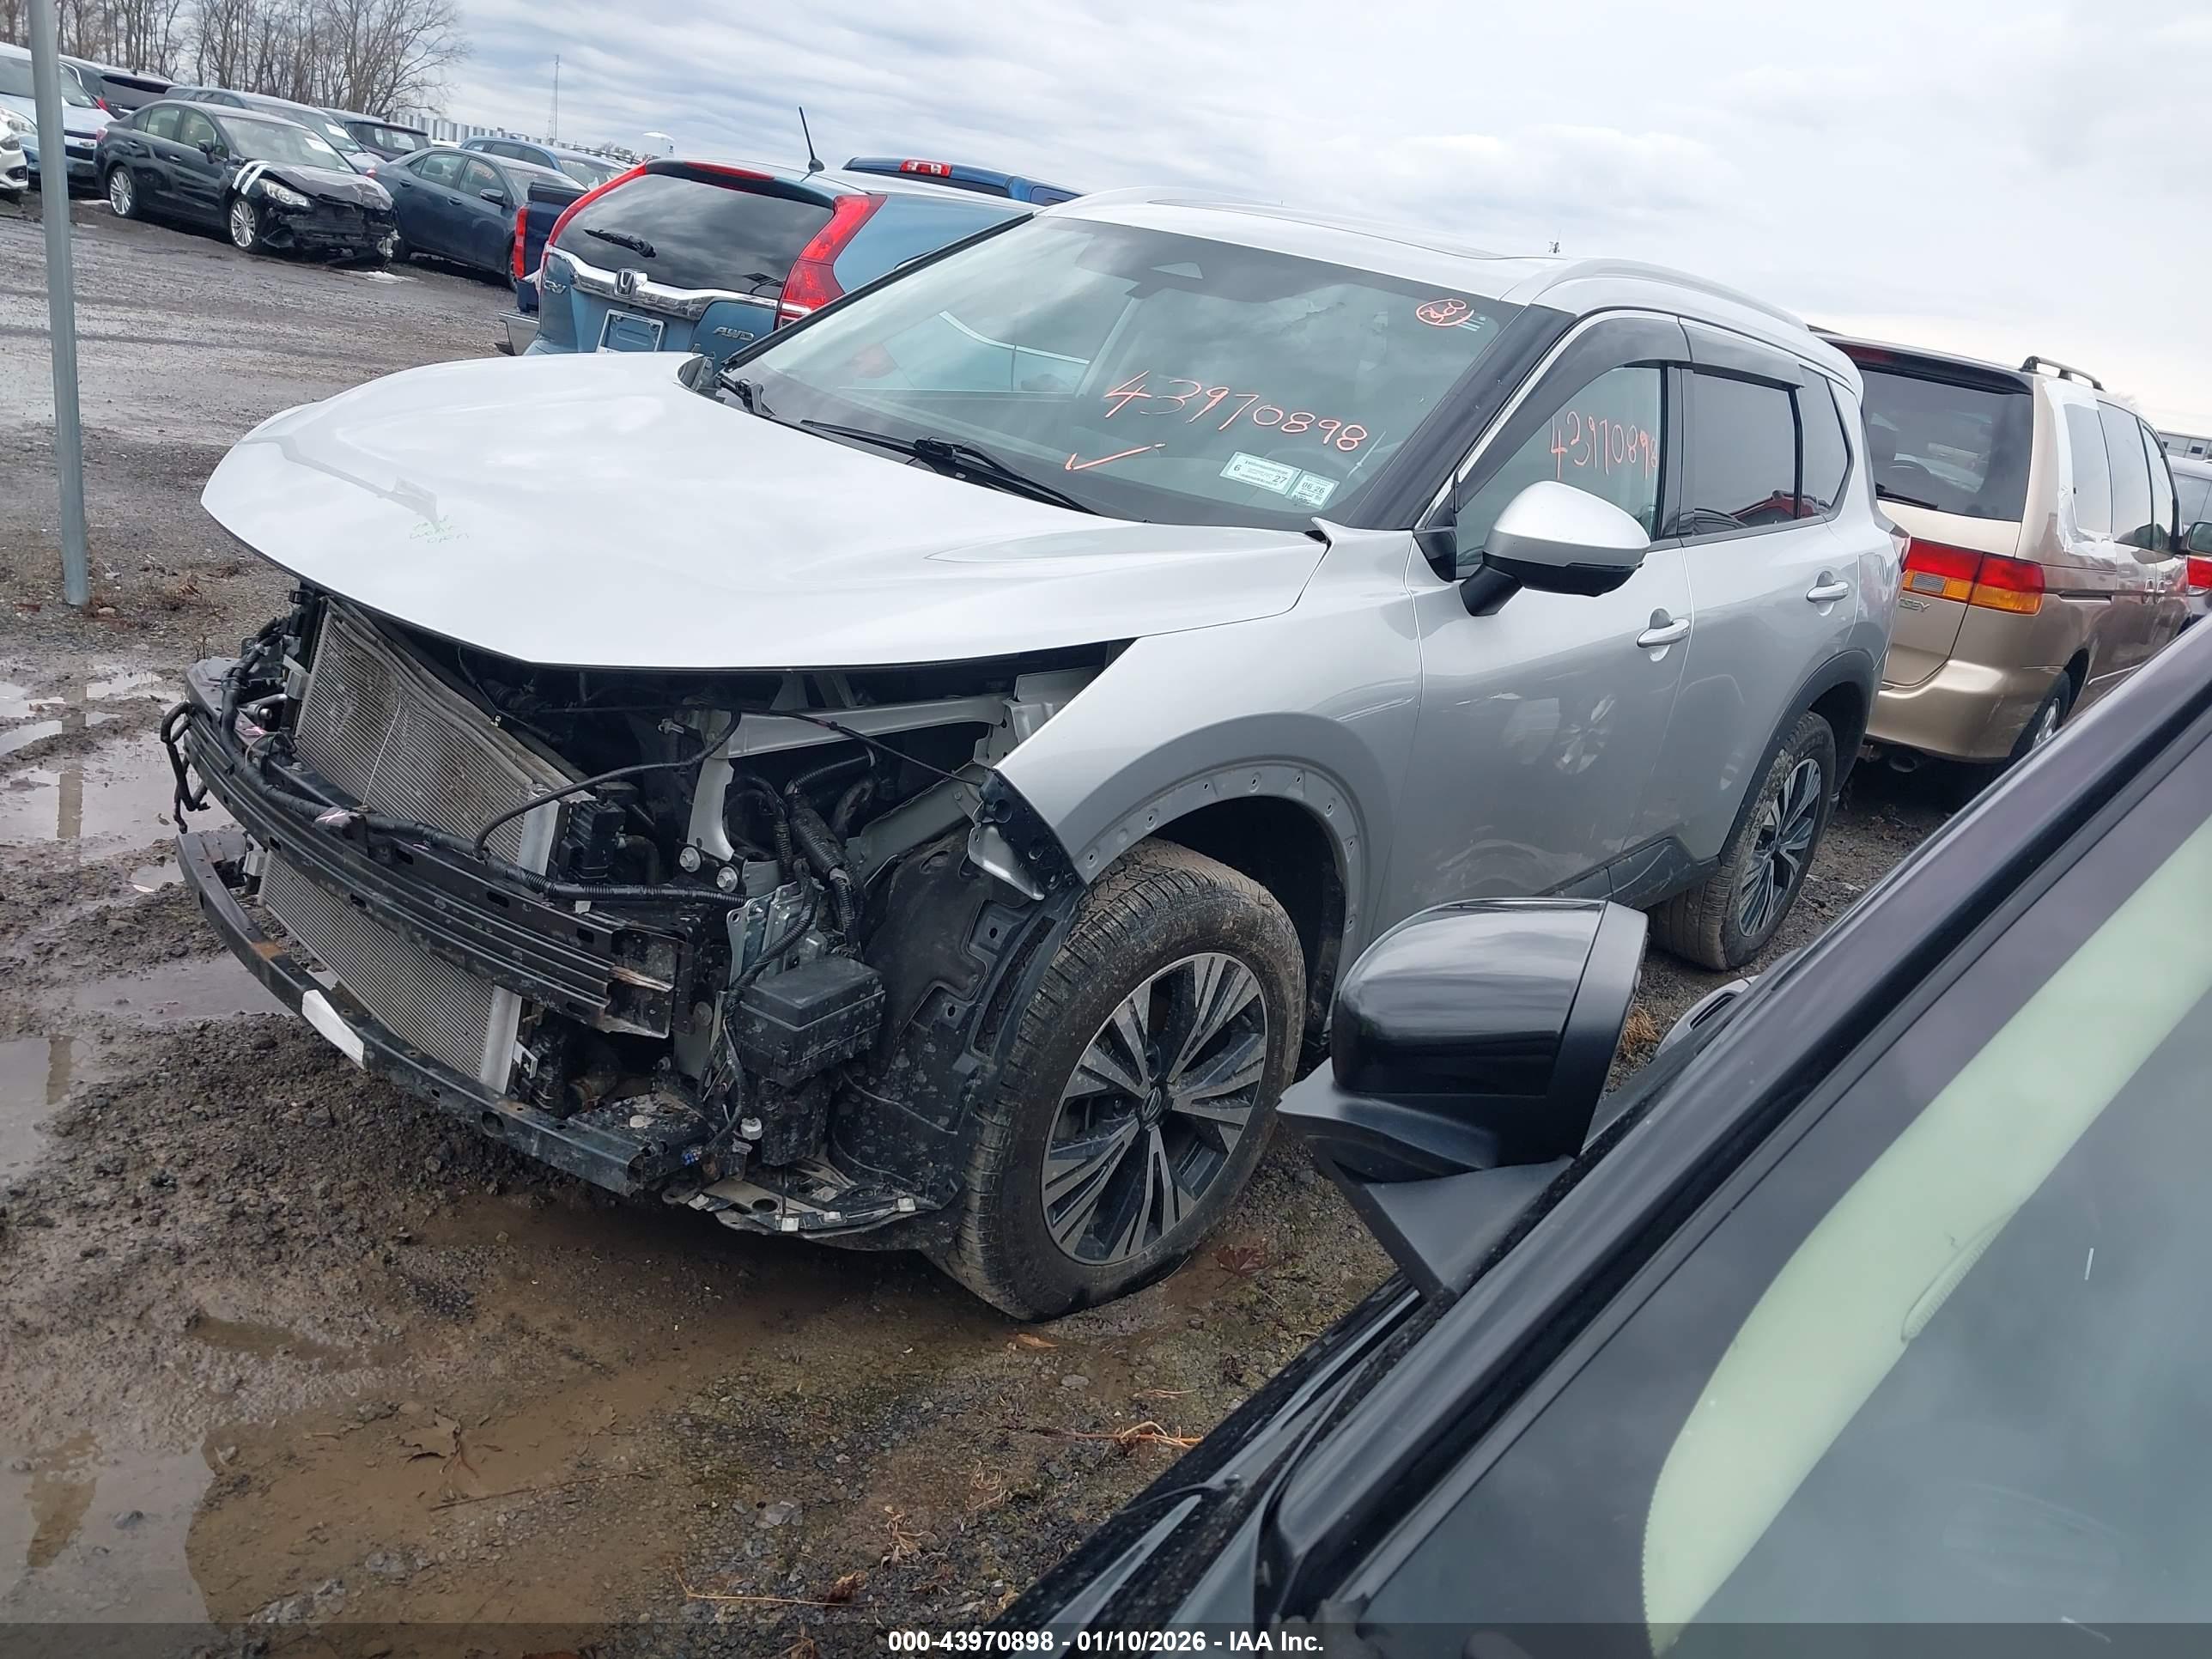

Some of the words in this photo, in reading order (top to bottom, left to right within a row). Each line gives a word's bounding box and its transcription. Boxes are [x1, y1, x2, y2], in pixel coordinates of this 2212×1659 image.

[713, 326, 755, 341] AWD
[1104, 370, 1368, 451] 43970898
[1551, 411, 1658, 479] 43970898
[1273, 475, 1288, 484] 27
